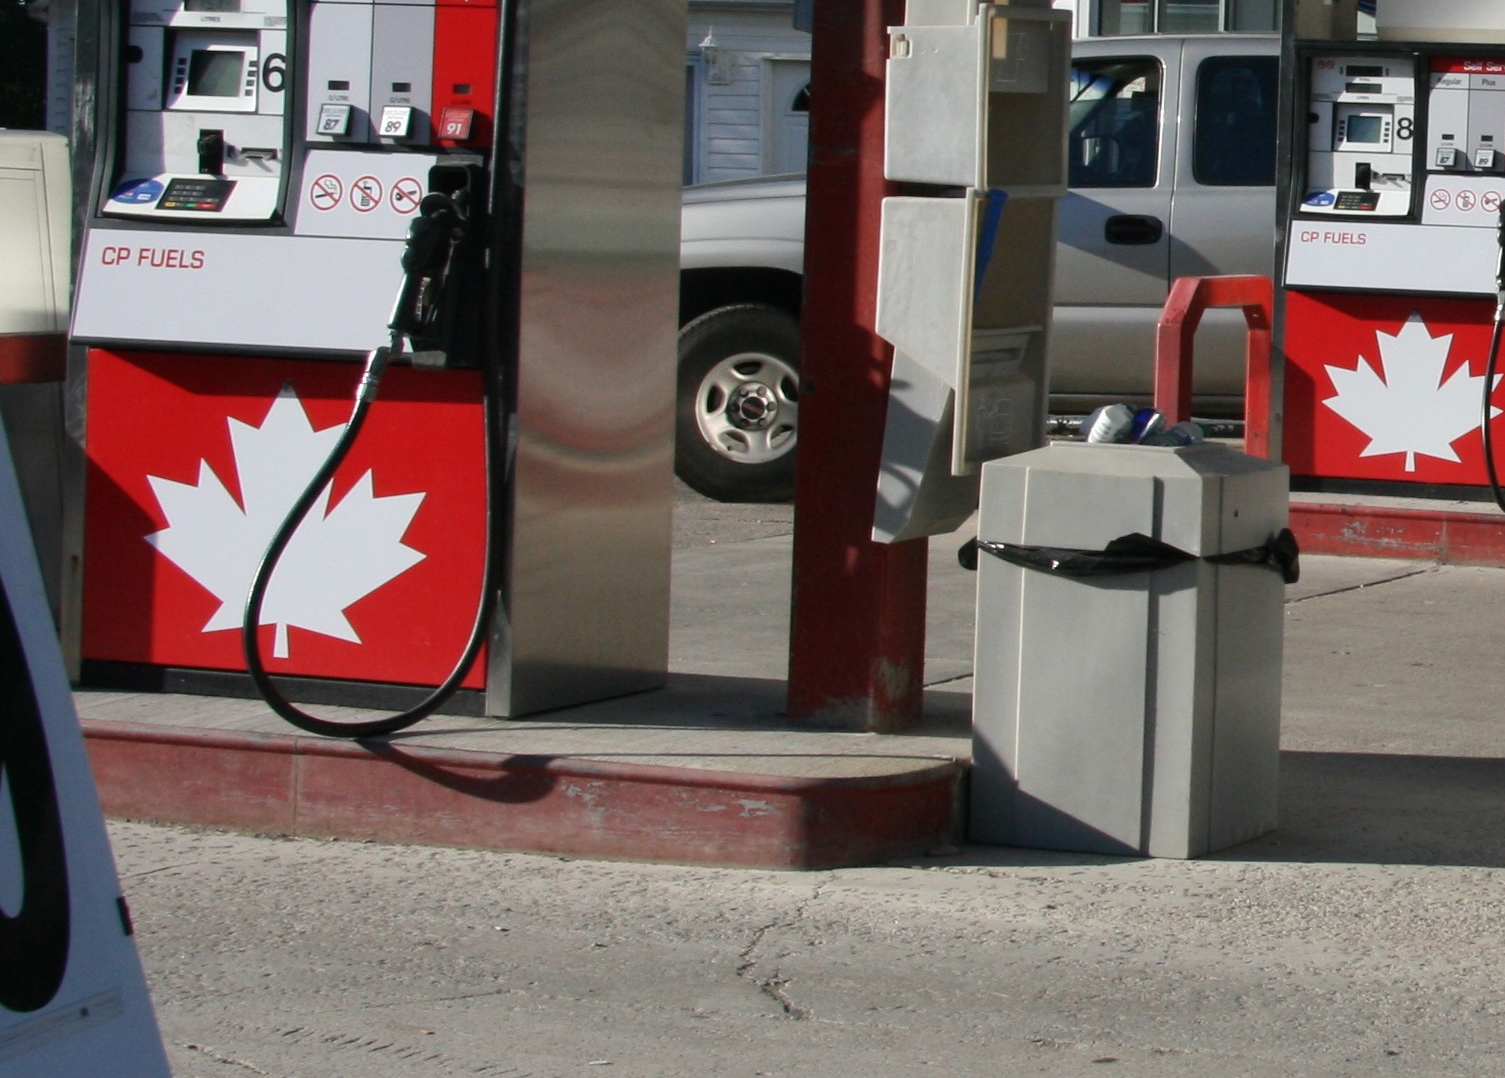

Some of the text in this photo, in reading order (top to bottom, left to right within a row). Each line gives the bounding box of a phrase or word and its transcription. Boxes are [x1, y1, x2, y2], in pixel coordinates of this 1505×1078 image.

[262, 53, 287, 93] 6
[323, 118, 339, 132] 87
[384, 120, 401, 134] 89
[446, 122, 462, 135] 91
[1396, 117, 1414, 141] 8
[1300, 230, 1367, 245] CP FUELS
[101, 246, 206, 270] CP FUELS
